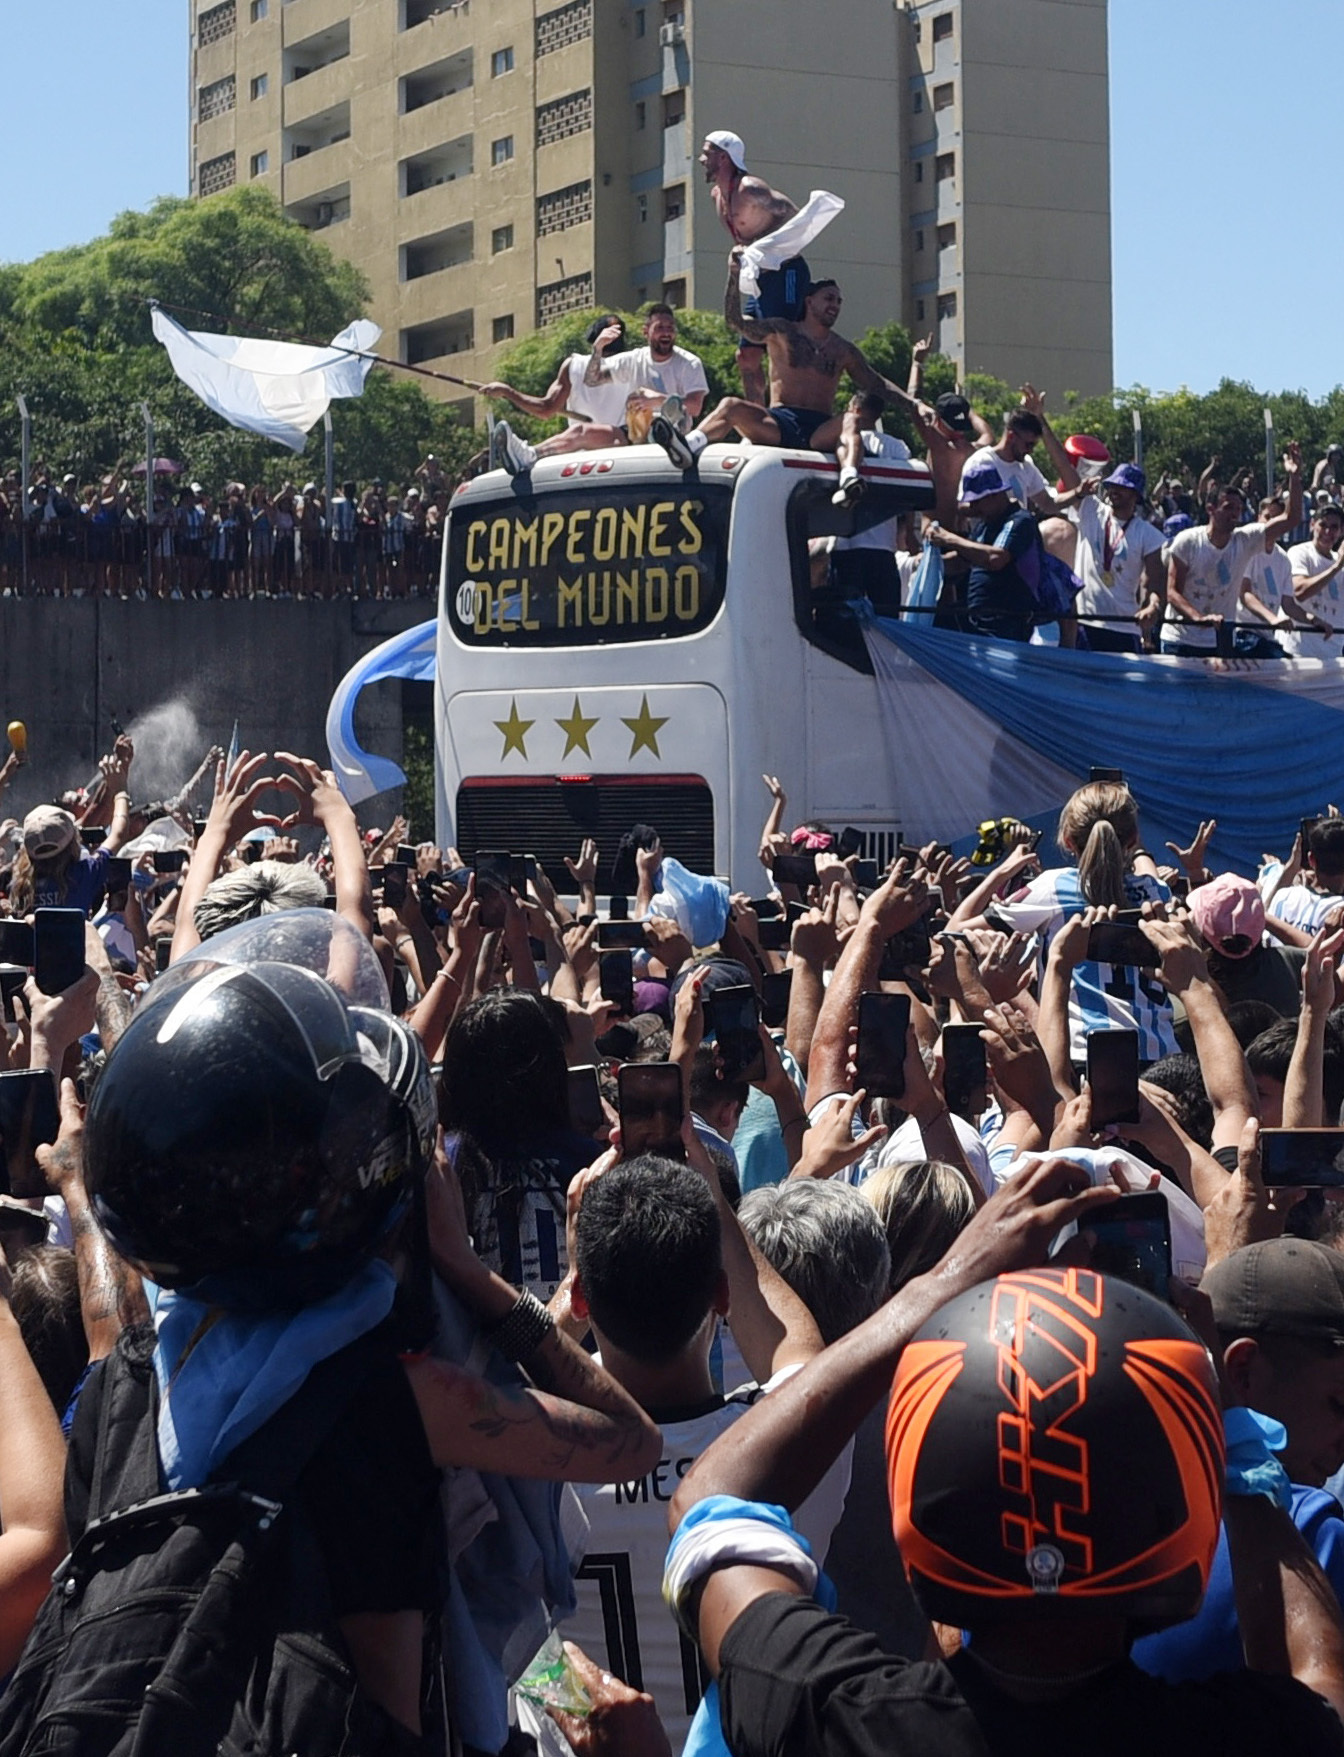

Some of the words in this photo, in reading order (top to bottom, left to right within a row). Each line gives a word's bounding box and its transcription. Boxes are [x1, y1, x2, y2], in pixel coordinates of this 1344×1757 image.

[466, 500, 704, 573] CAMPEONES
[474, 578, 540, 635] DEL
[557, 565, 699, 627] MUNDO
